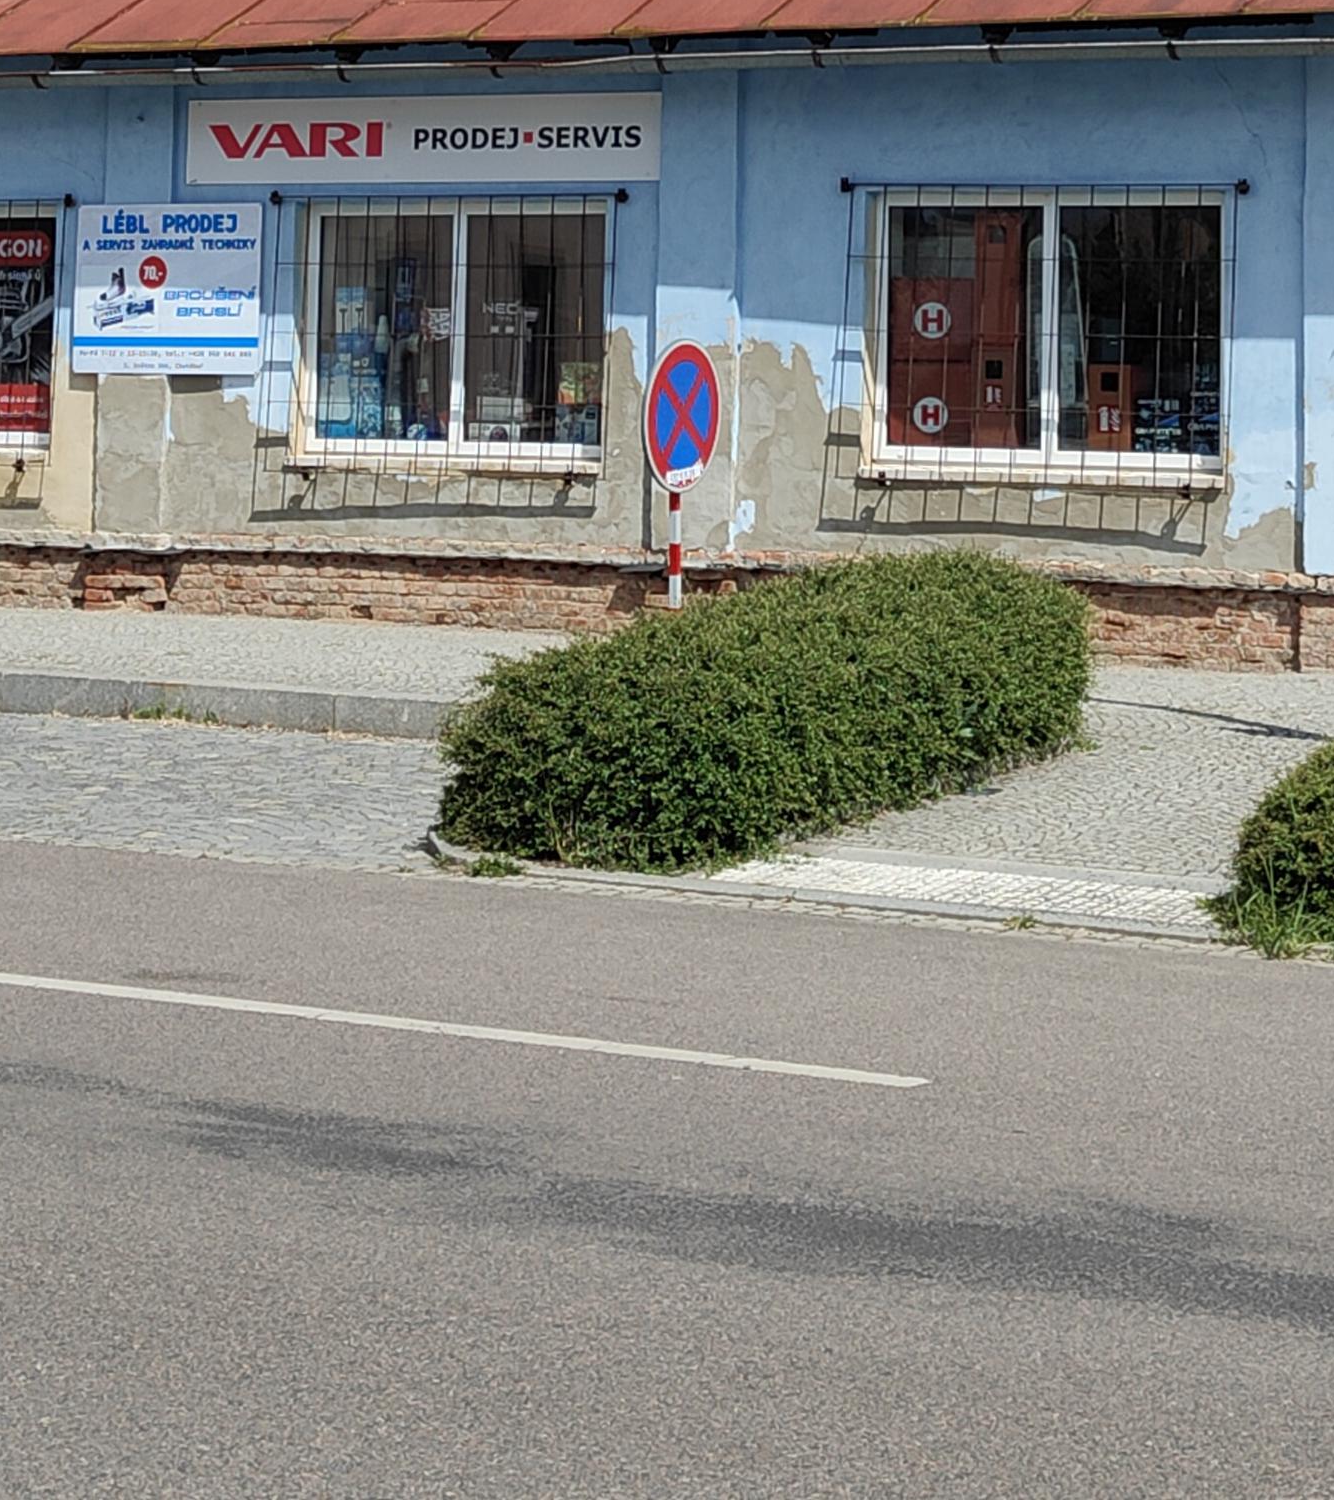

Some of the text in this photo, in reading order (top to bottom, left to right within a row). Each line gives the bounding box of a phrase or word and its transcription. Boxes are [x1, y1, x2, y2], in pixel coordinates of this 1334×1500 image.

[208, 121, 385, 159] VARI
[413, 124, 643, 151] PRODEJ SERVIS
[101, 209, 239, 235] LÉBL PRODEJ
[82, 239, 92, 251] A
[96, 239, 135, 251] SERVIS
[201, 238, 257, 251] TECHNIKY
[142, 265, 164, 282] 70,-
[163, 285, 257, 301] BROUŠENÍ
[176, 302, 243, 318] BRUSLÍ
[921, 308, 944, 332] H
[920, 404, 941, 427] H
